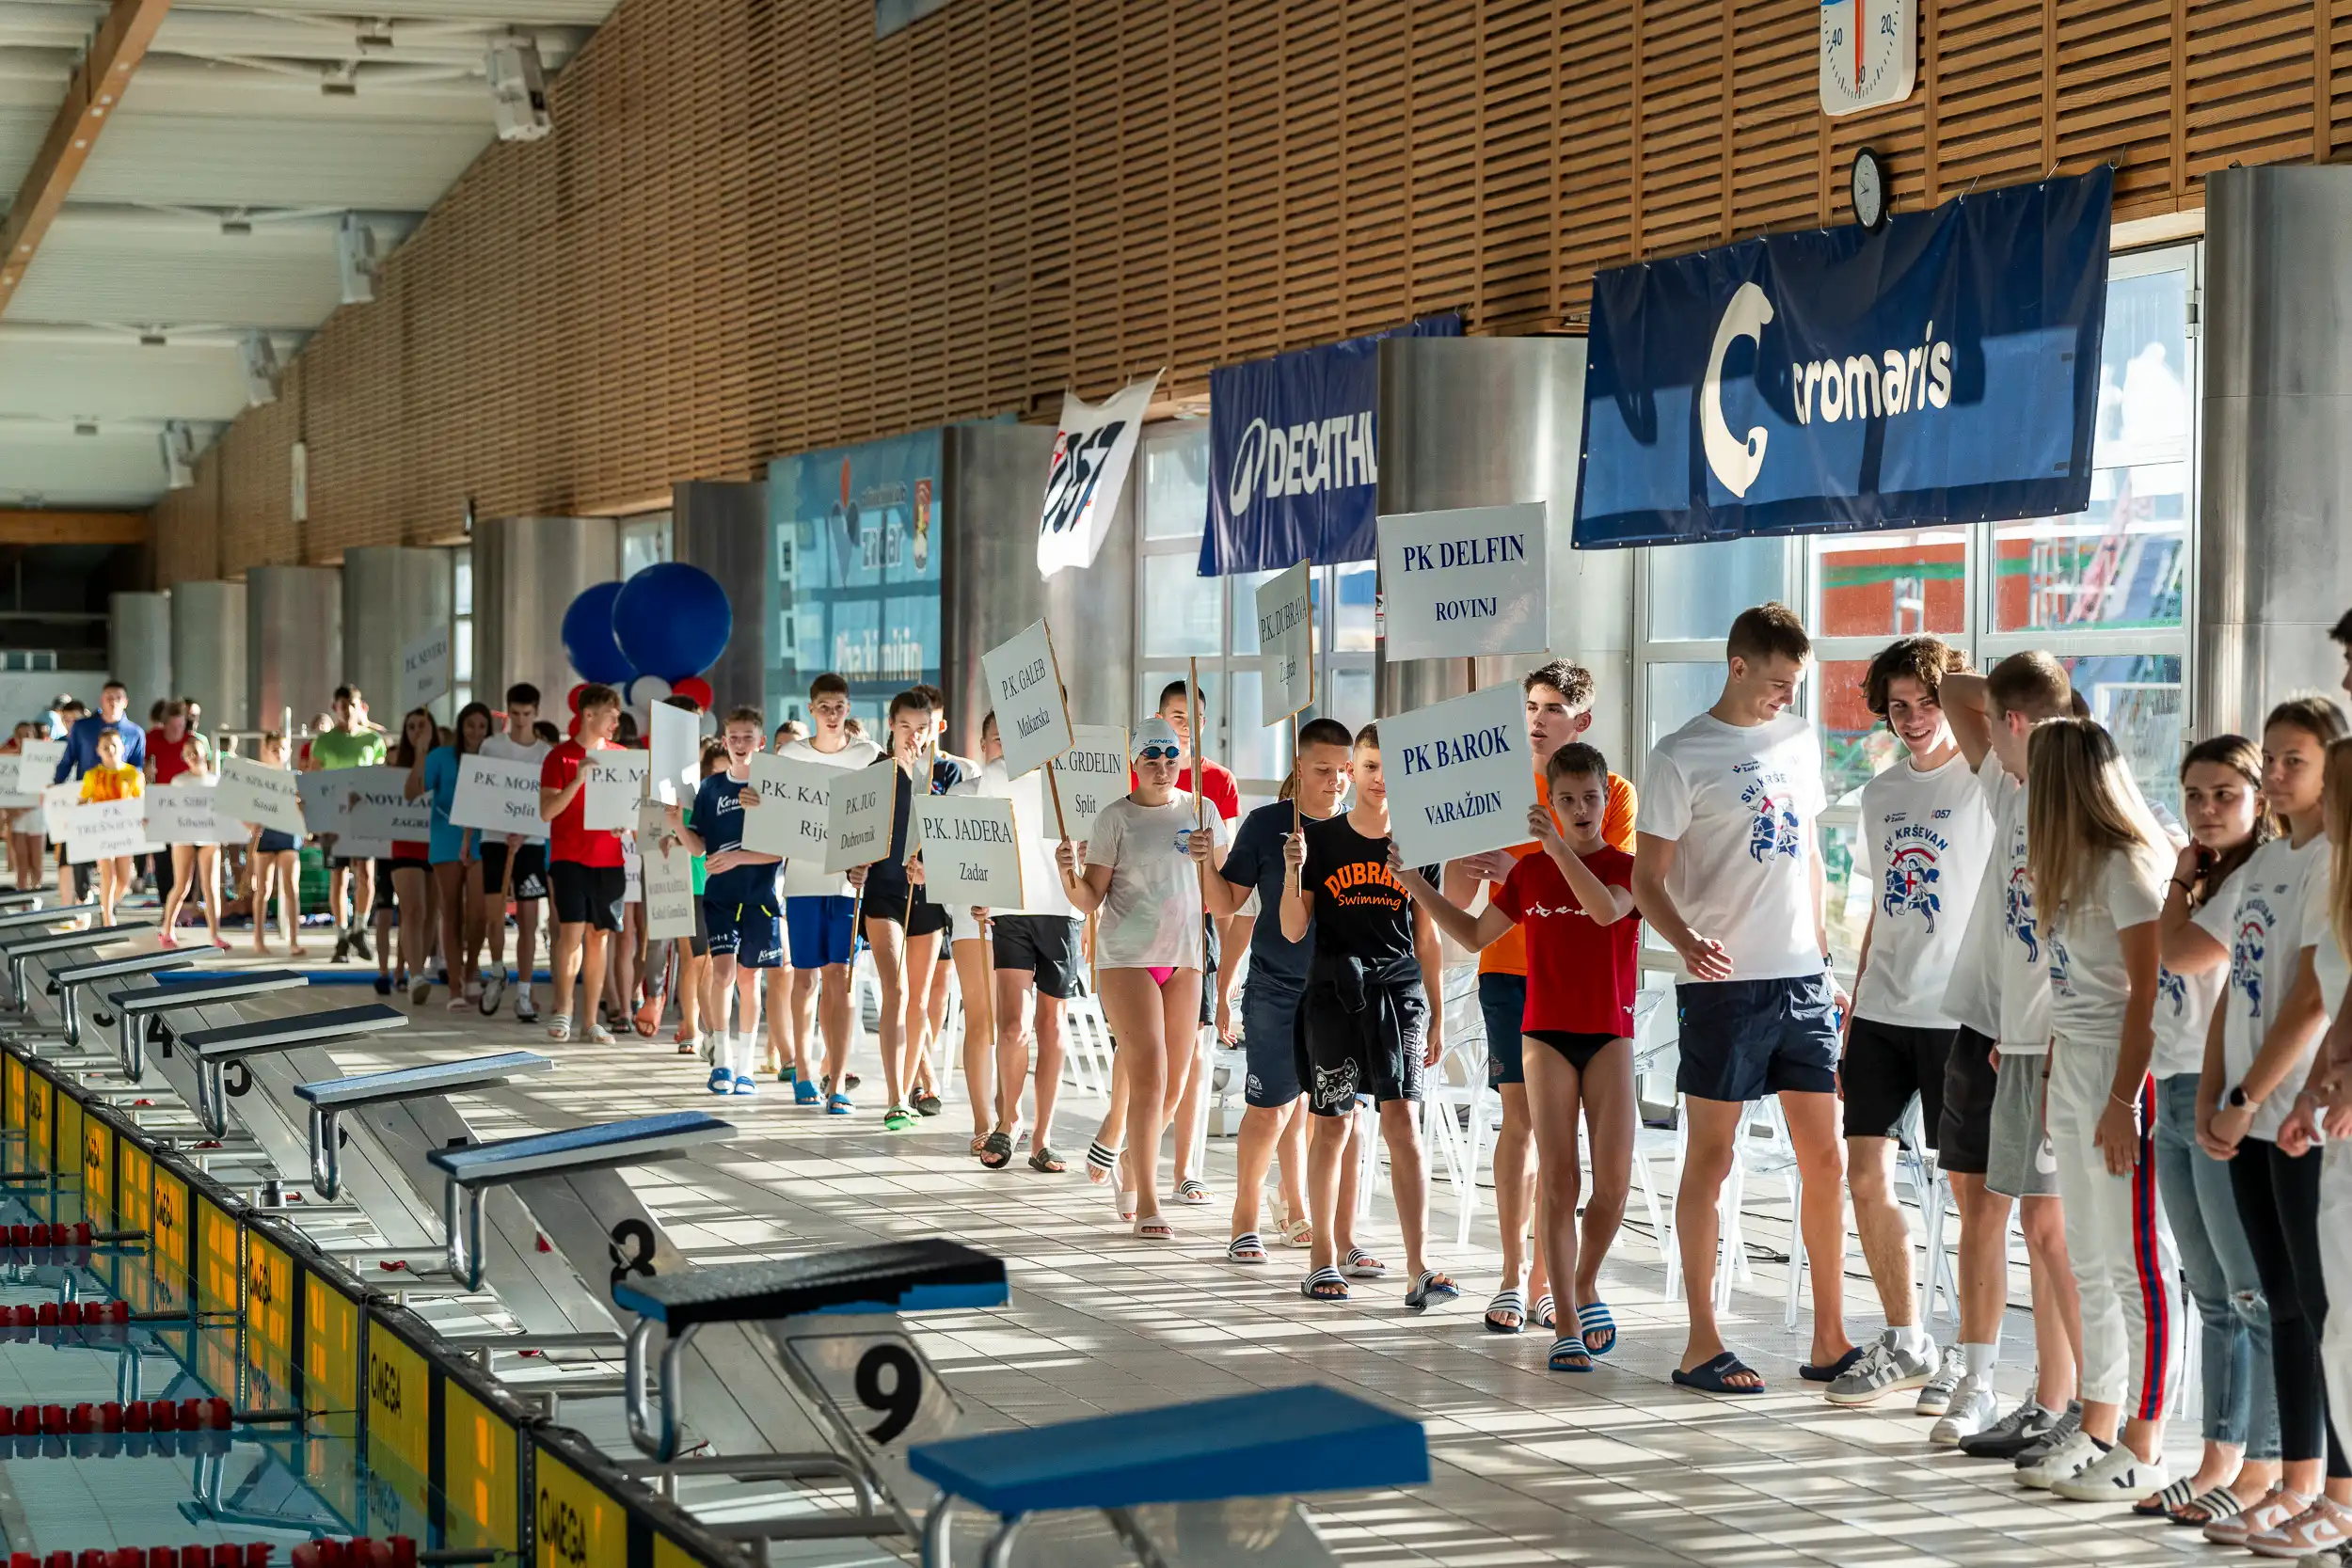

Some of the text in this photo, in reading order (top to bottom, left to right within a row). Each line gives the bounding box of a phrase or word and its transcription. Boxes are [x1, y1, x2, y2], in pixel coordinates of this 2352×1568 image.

[1832, 27, 1843, 47] 40
[1881, 14, 1892, 34] 20
[1793, 321, 1952, 425] cromaris
[1403, 534, 1525, 572] PK DELFIN
[1276, 595, 1307, 637] DUBRAVA
[1435, 596, 1498, 622] ROVINJ
[1001, 658, 1046, 701] P.K. GALEB
[1017, 707, 1051, 739] Makarska
[1069, 751, 1121, 774] GRDELIN
[1402, 724, 1511, 775] PK BAROK
[474, 771, 499, 787] P.K.
[592, 768, 623, 783] P.K.
[761, 780, 791, 800] P.K.
[846, 791, 877, 816] P.K. JUG
[503, 800, 535, 817] Split
[1075, 794, 1096, 817] Split
[1424, 790, 1502, 826] VARAŽDIN
[841, 825, 876, 850] Dubrovnik
[923, 817, 1013, 843] P.K. JADERA
[1895, 823, 1948, 851] KRŠEVAN
[959, 863, 988, 882] Zadar
[1324, 861, 1408, 899] DUBRA
[1338, 892, 1402, 911] Swimming
[147, 1012, 174, 1058] 4
[249, 1256, 272, 1308] OMEGA
[371, 1351, 402, 1419] OMEGA
[855, 1344, 922, 1445] 9
[540, 1486, 587, 1568] OMEGA
